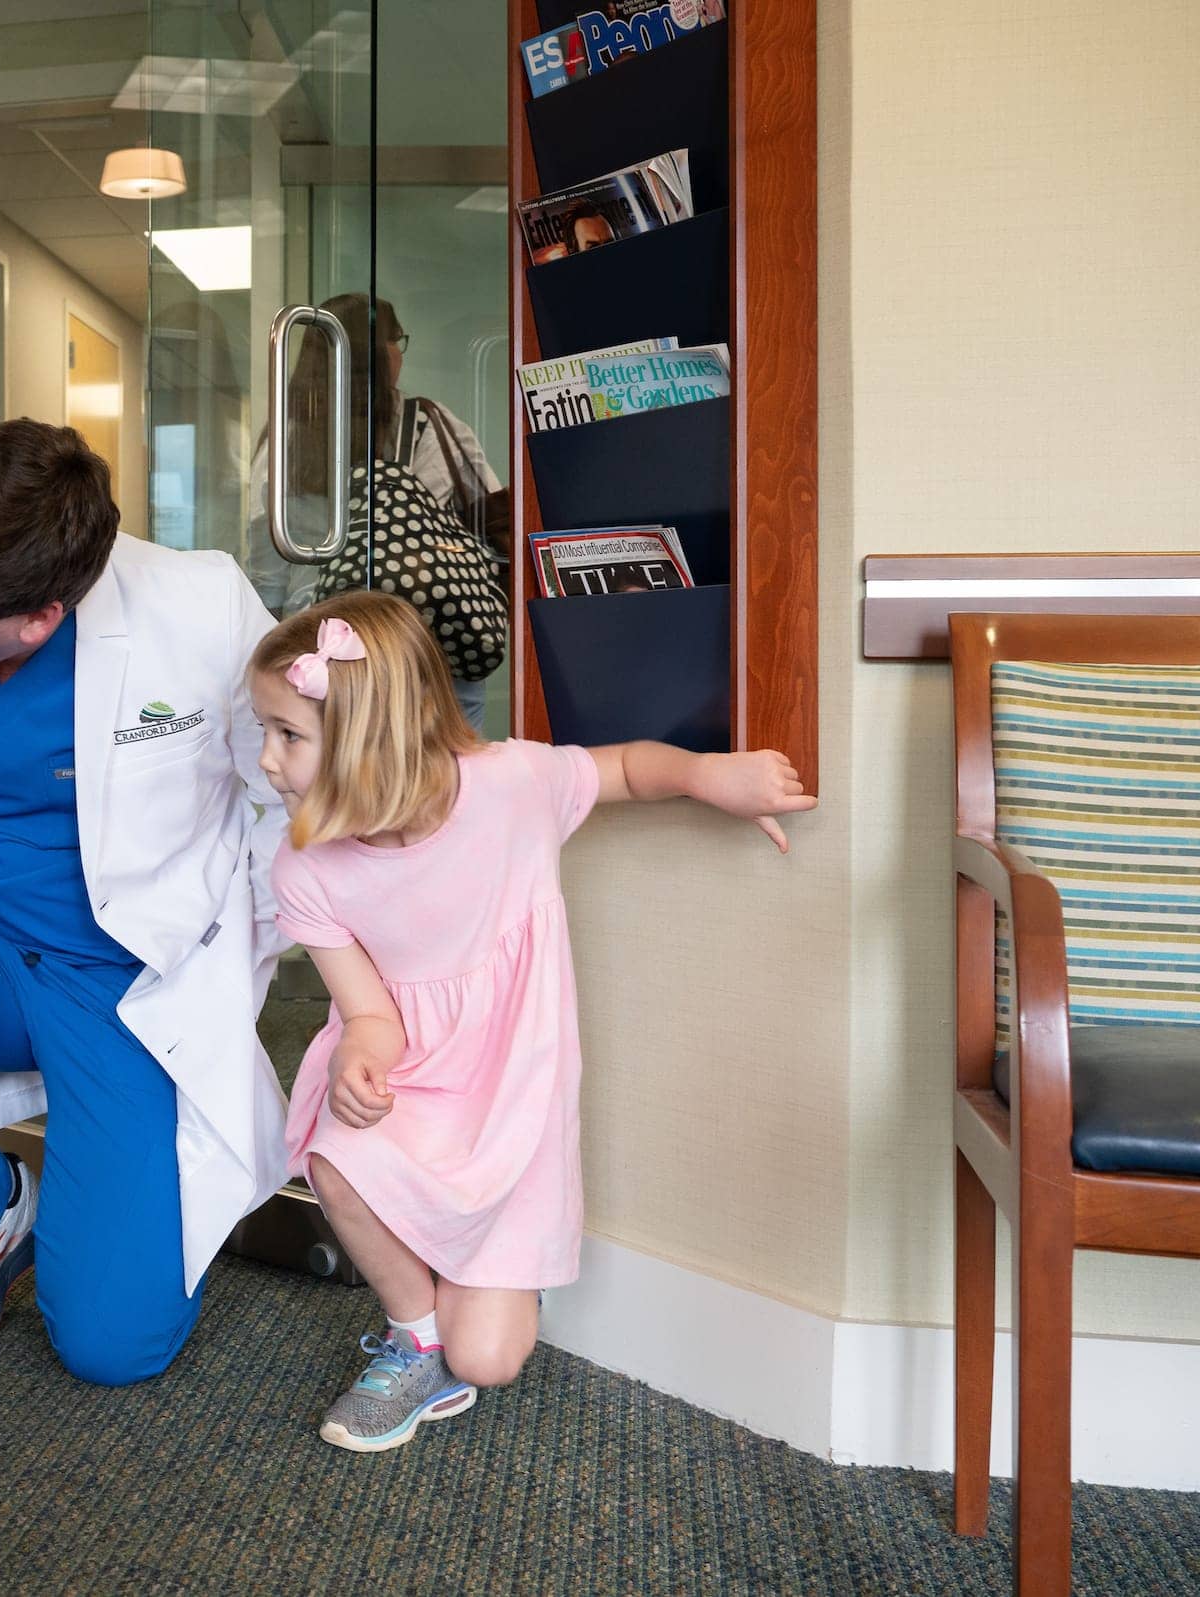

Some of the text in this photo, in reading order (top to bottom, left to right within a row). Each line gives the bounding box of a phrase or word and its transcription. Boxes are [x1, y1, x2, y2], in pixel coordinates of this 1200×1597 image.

[522, 363, 565, 387] KEEP
[569, 358, 586, 378] IT
[587, 362, 646, 388] Better
[647, 357, 722, 381] Homes
[607, 380, 717, 411] & Gardens
[565, 543, 584, 558] Most
[584, 540, 622, 556] Influential
[622, 539, 664, 555] Companies
[569, 564, 668, 595] TIE
